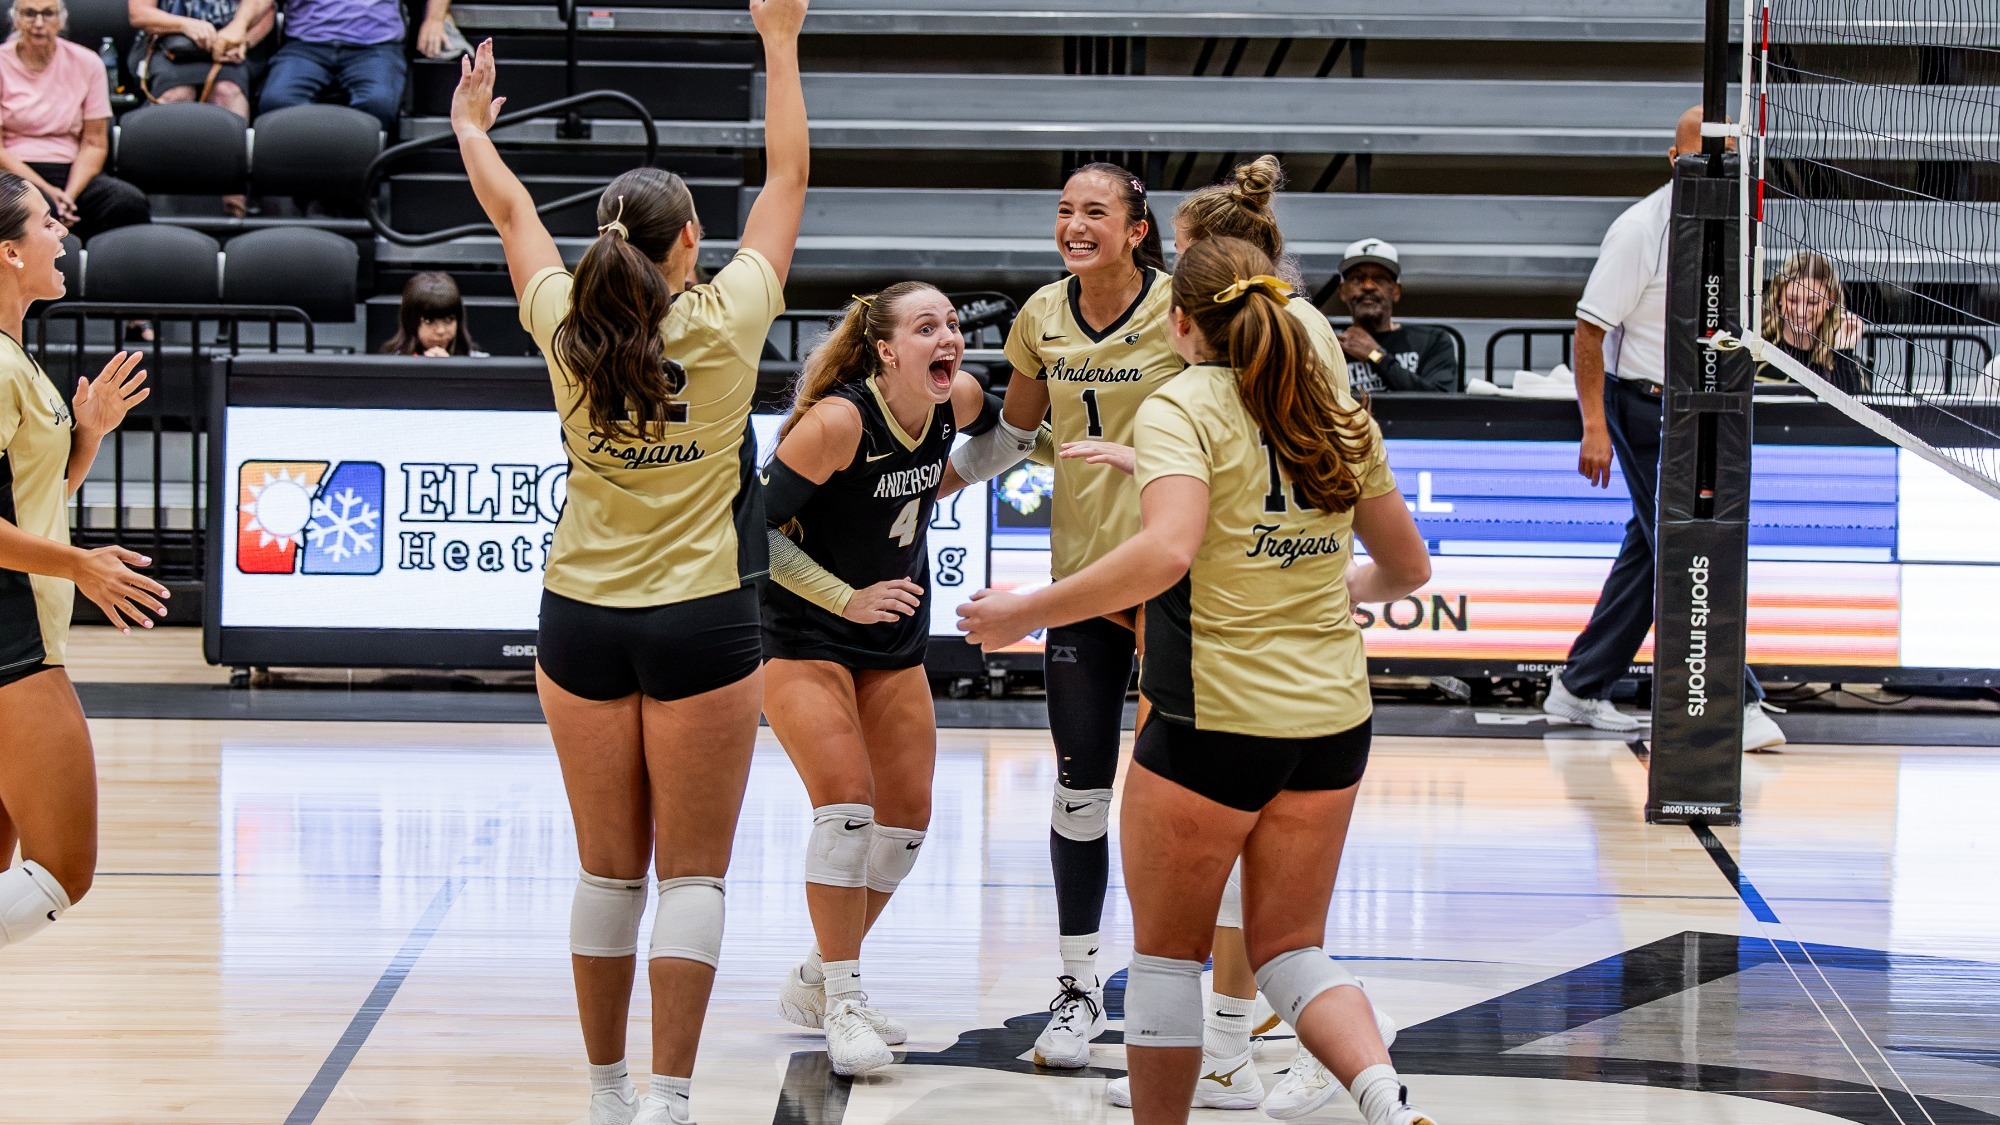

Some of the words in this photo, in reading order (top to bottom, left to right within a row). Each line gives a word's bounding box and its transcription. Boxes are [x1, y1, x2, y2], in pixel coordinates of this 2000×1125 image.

[1705, 275, 1720, 328] sports
[1050, 356, 1143, 383] Anderson
[1703, 345, 1717, 393] ports
[1081, 387, 1104, 439] 1
[587, 431, 705, 469] Trojans
[873, 458, 943, 498] ANDERSON
[888, 498, 921, 548] 4
[1246, 524, 1340, 569] Trojans
[1688, 555, 1711, 627] sports
[1685, 629, 1708, 717] imports
[1662, 805, 1683, 815] (800)
[1684, 806, 1721, 815] 556-3198
